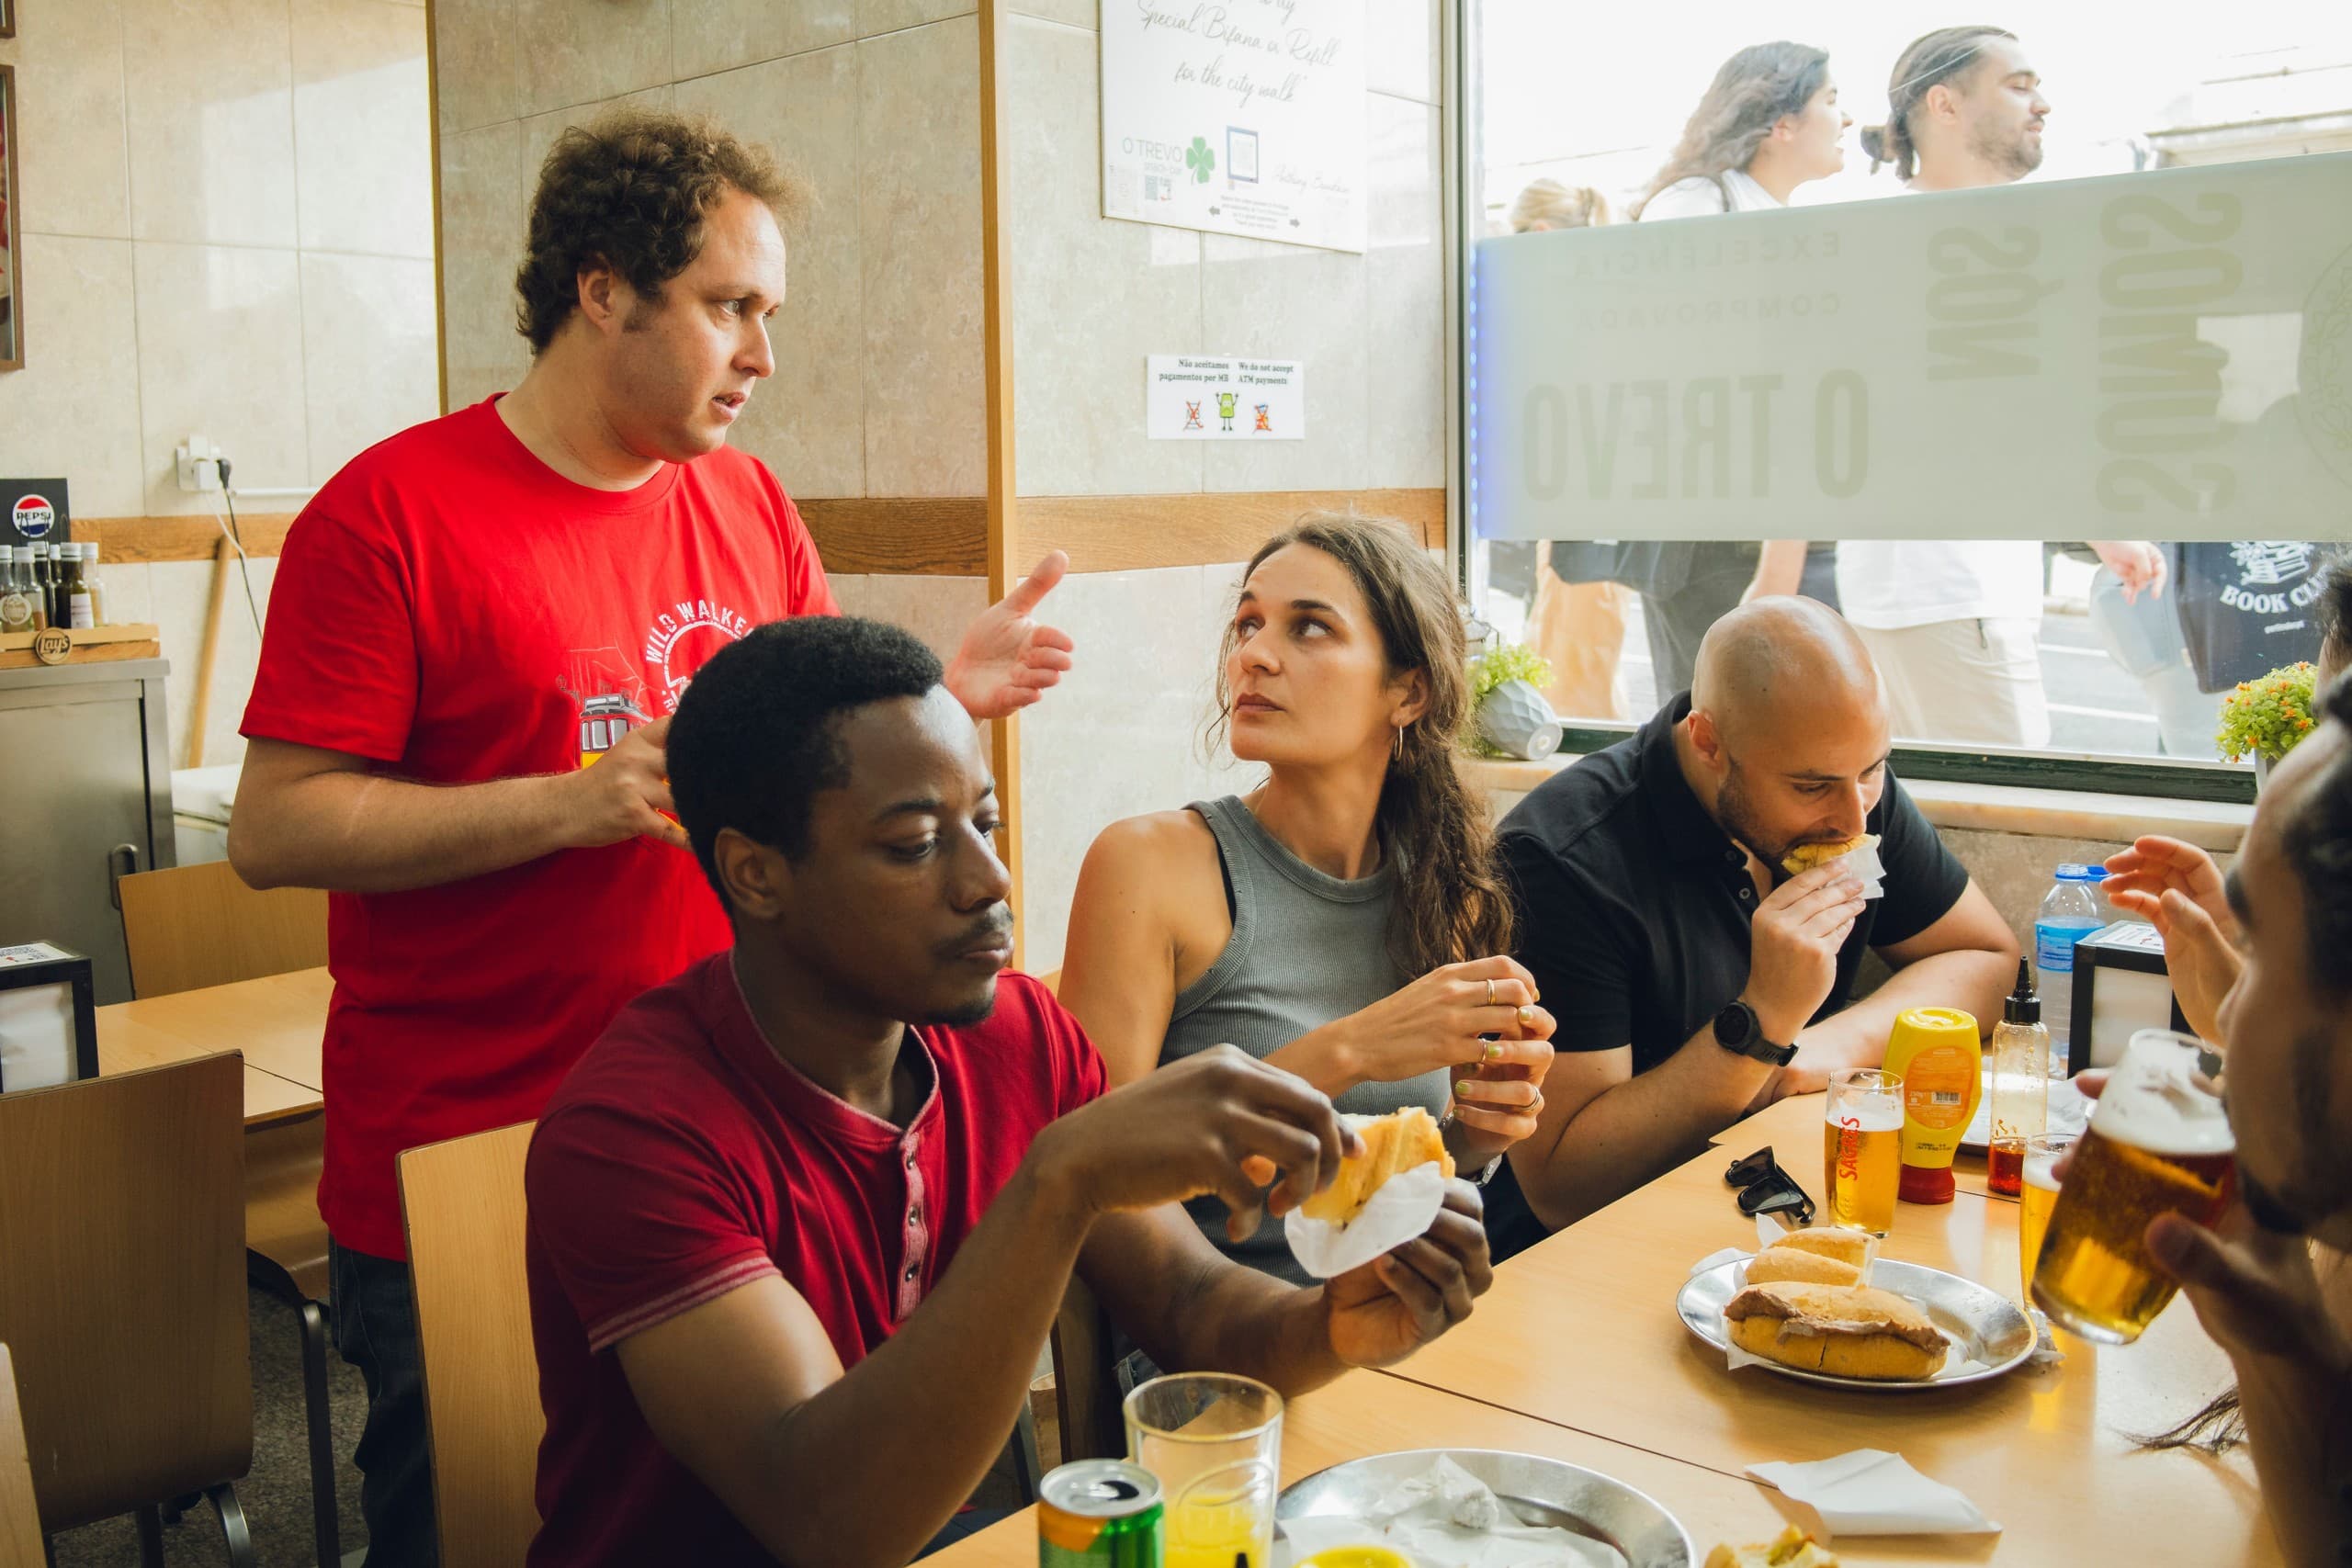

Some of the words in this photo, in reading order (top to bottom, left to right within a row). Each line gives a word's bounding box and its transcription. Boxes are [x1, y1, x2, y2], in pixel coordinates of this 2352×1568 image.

[1137, 0, 1204, 30] Special
[1286, 28, 1341, 67] Refill
[1174, 61, 1195, 83] for
[1200, 54, 1223, 88] the
[1227, 73, 1255, 108] city
[1123, 137, 1133, 154] O
[1136, 139, 1183, 163] TREVO
[1178, 358, 1193, 367] Não
[1250, 362, 1258, 371] do
[1272, 365, 1294, 374] accept
[1159, 373, 1203, 382] pagamentos
[1238, 375, 1253, 383] ATM
[17, 512, 51, 521] PEPSI
[2220, 584, 2289, 614] BOOK
[646, 614, 678, 664] WILD
[676, 600, 754, 636] WALKE
